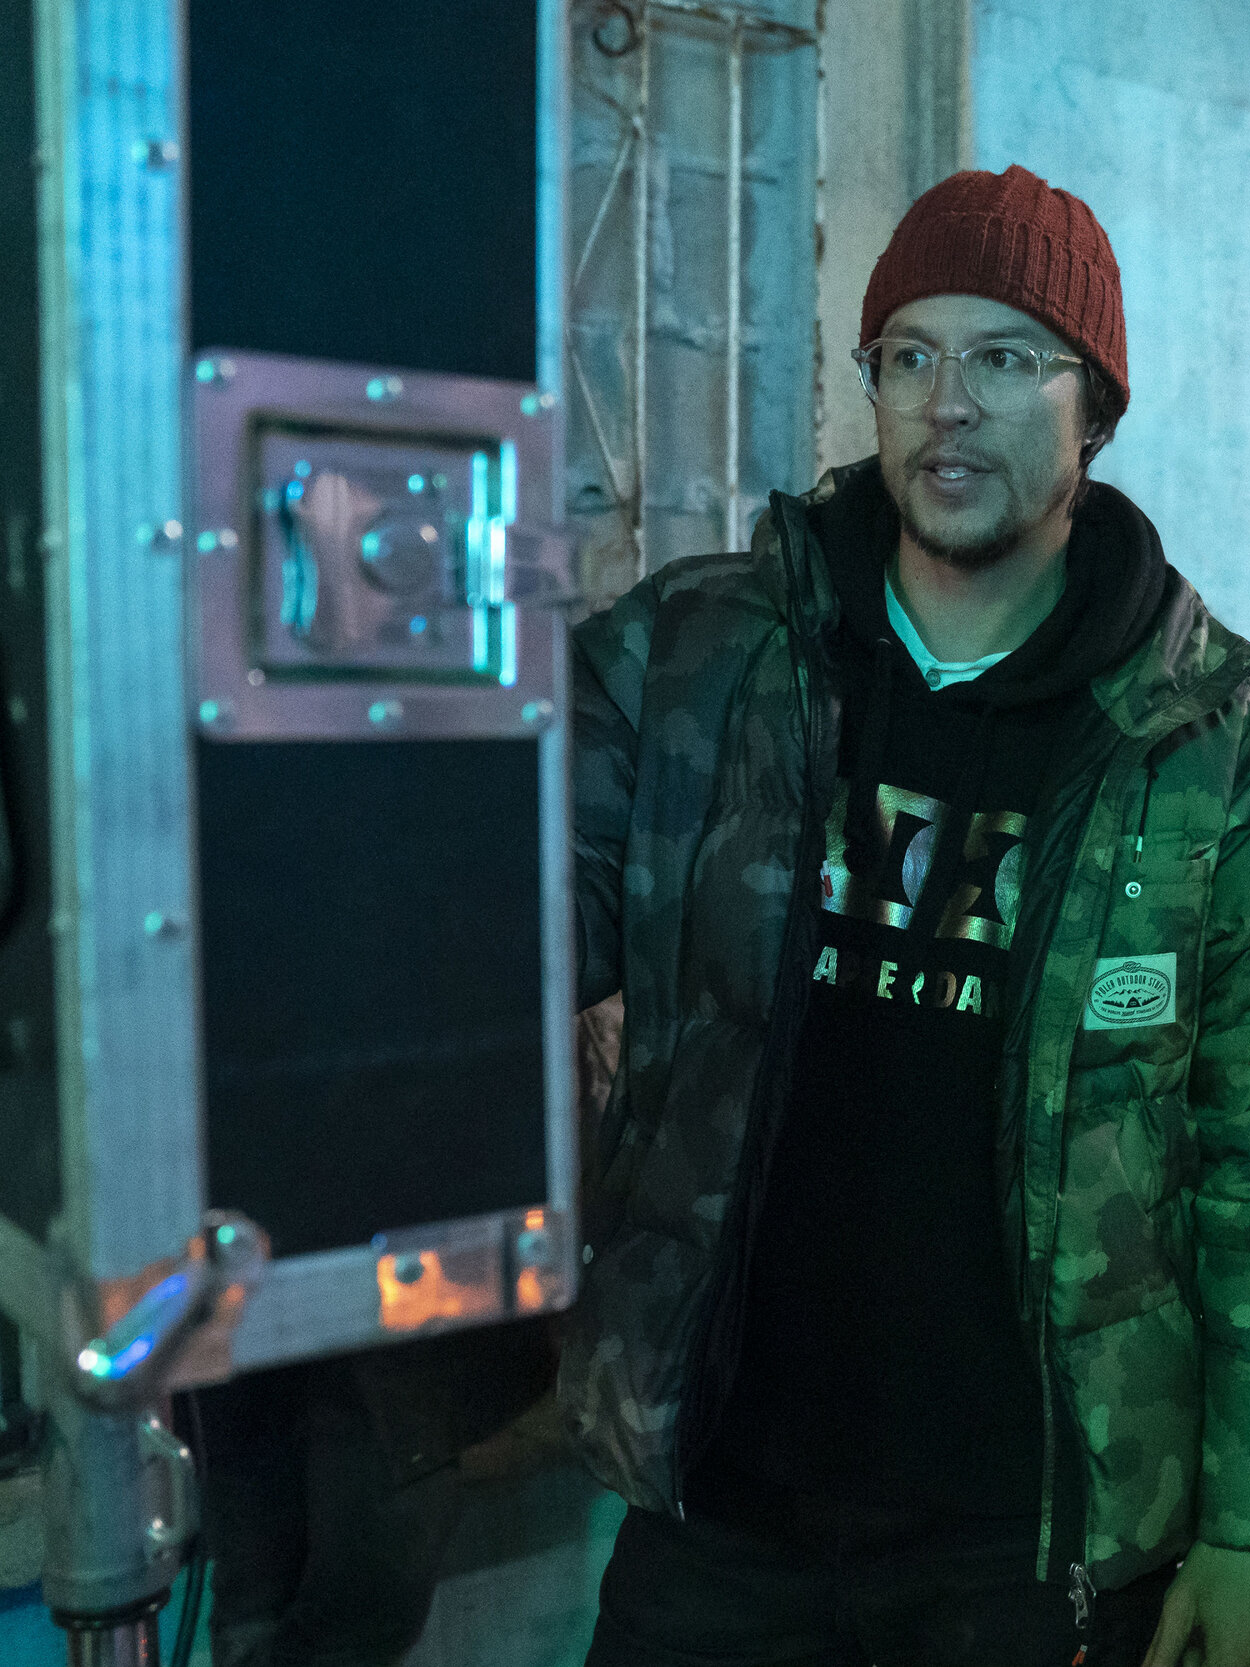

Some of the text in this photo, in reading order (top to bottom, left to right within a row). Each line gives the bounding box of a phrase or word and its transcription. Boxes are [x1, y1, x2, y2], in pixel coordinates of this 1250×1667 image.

[1095, 975, 1166, 997] POLER OUTDOOR STUFF
